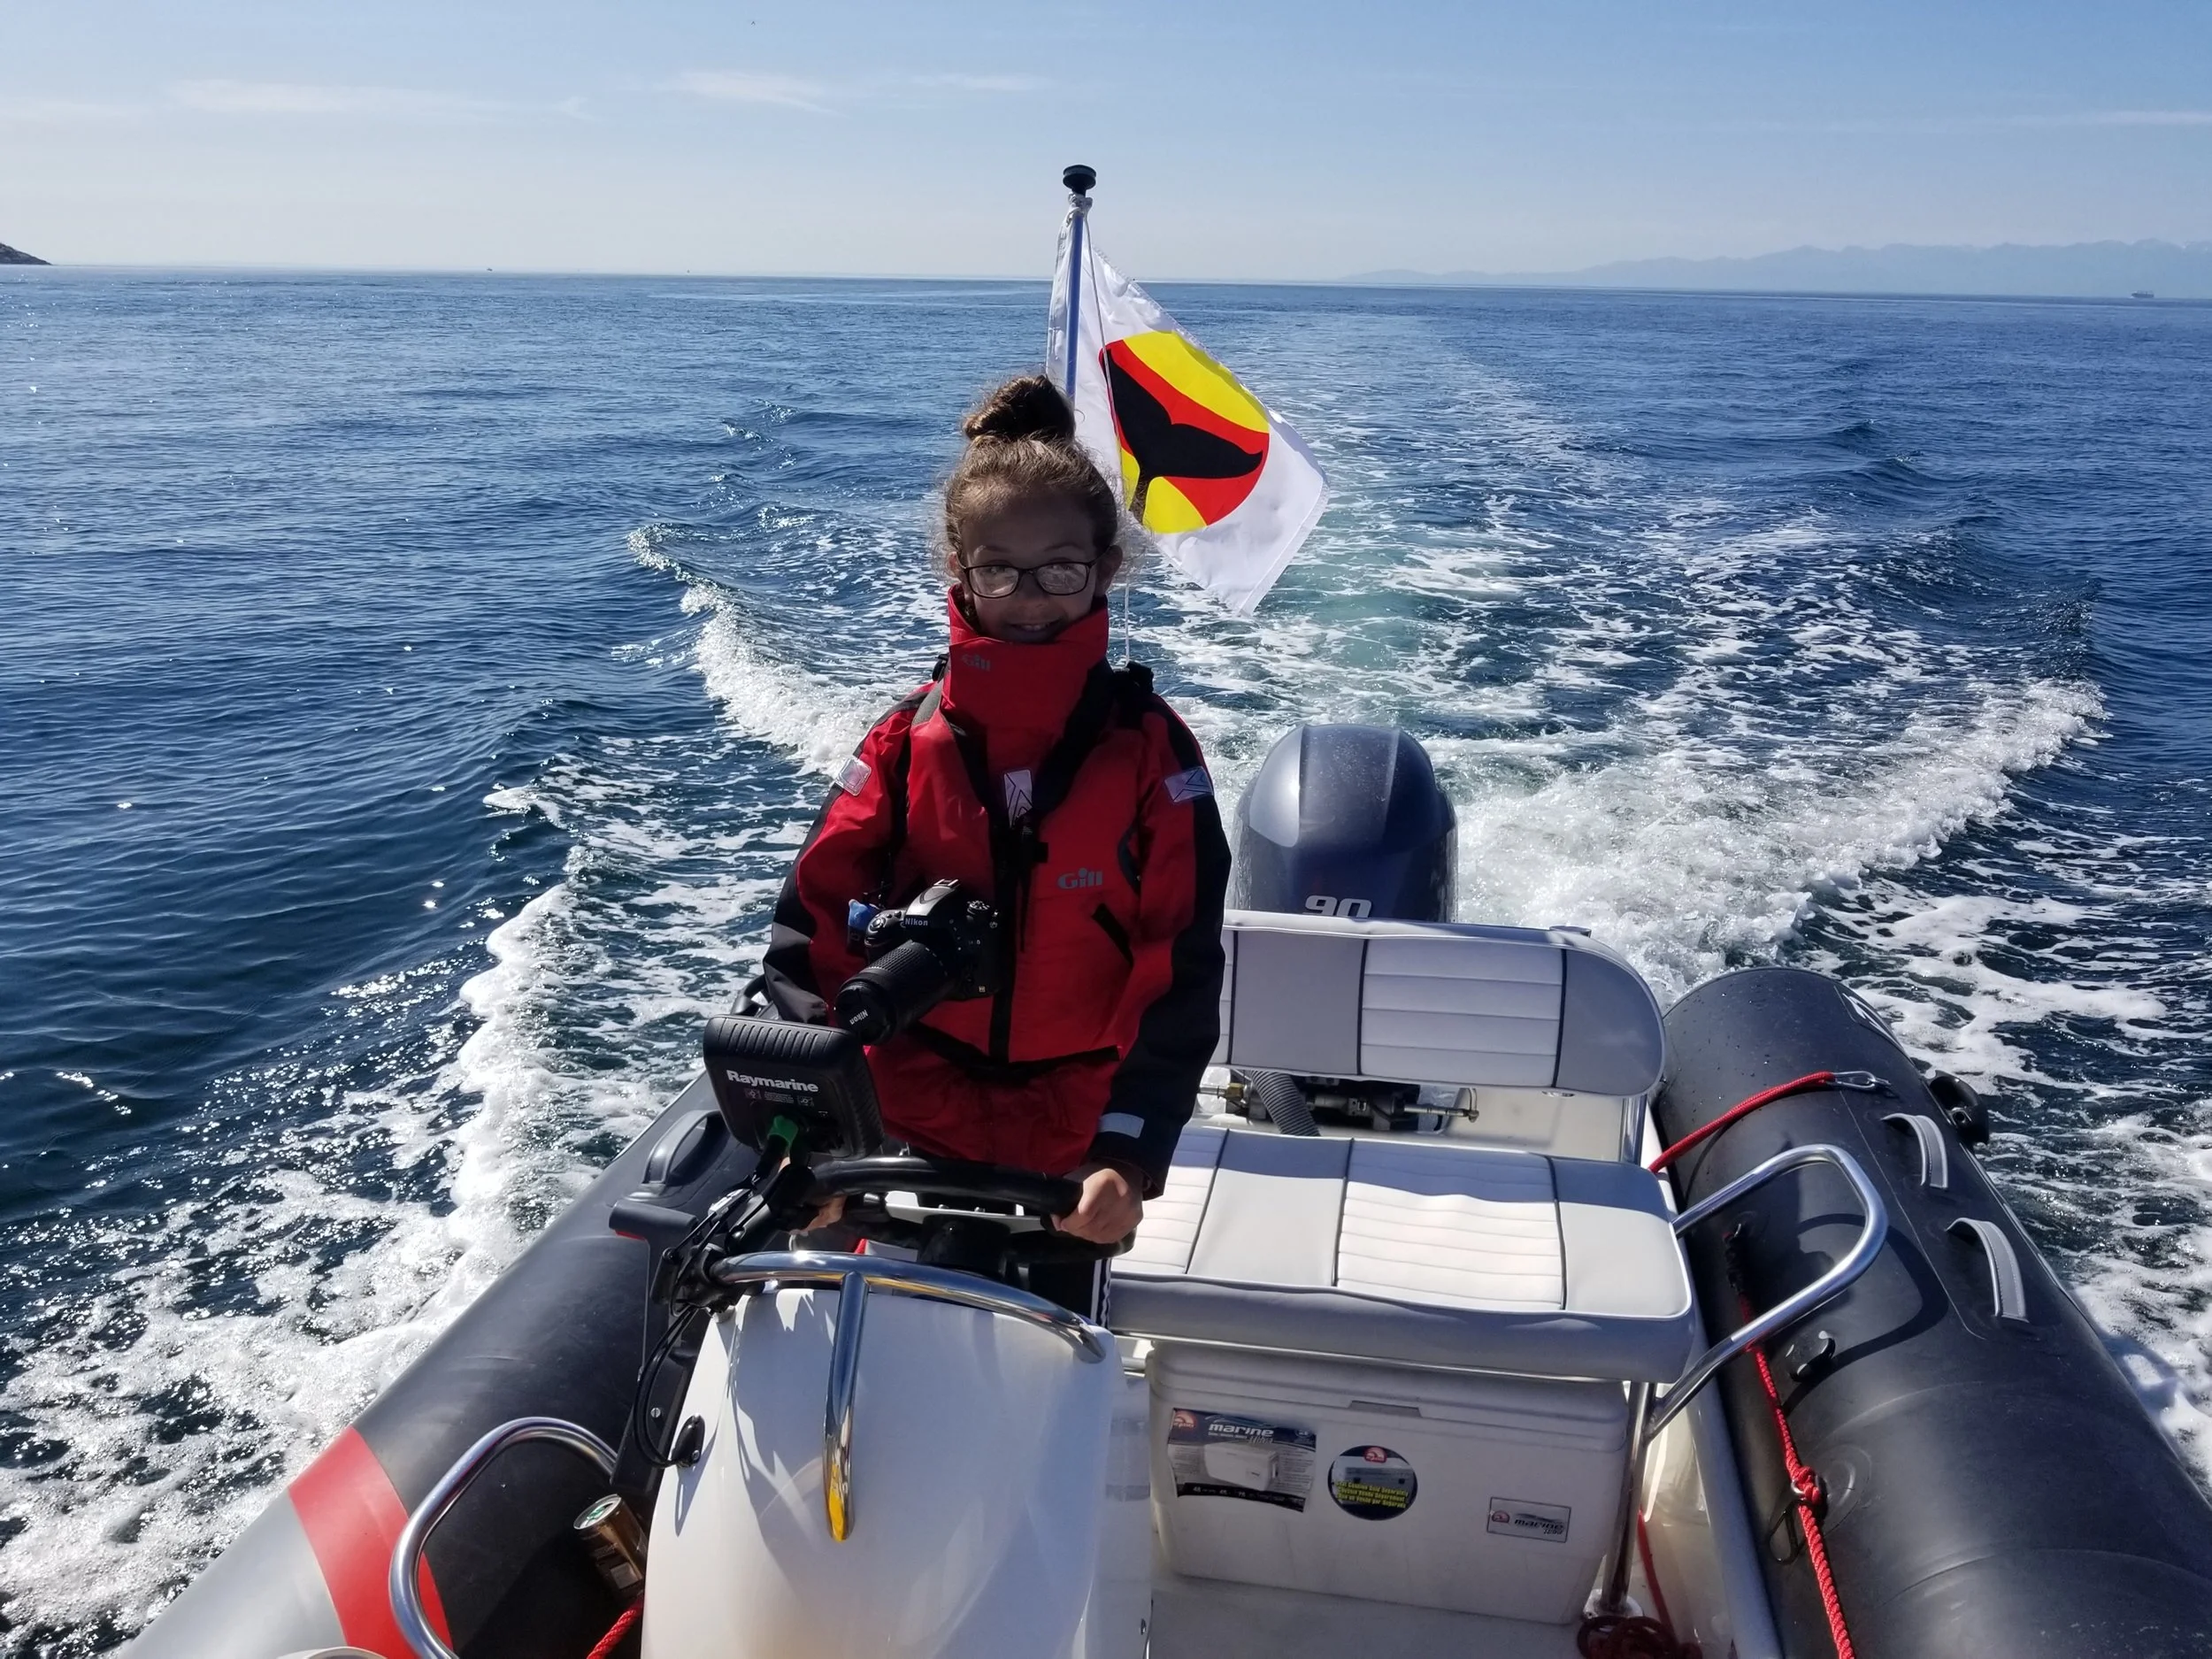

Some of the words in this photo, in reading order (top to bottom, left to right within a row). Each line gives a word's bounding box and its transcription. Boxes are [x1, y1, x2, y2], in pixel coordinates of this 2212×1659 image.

[1057, 868, 1103, 889] Gill
[1302, 895, 1372, 918] 90
[904, 918, 929, 926] Nikon
[849, 1009, 869, 1025] Nikon
[726, 1069, 819, 1093] Raymarine
[1208, 1423, 1275, 1437] marine
